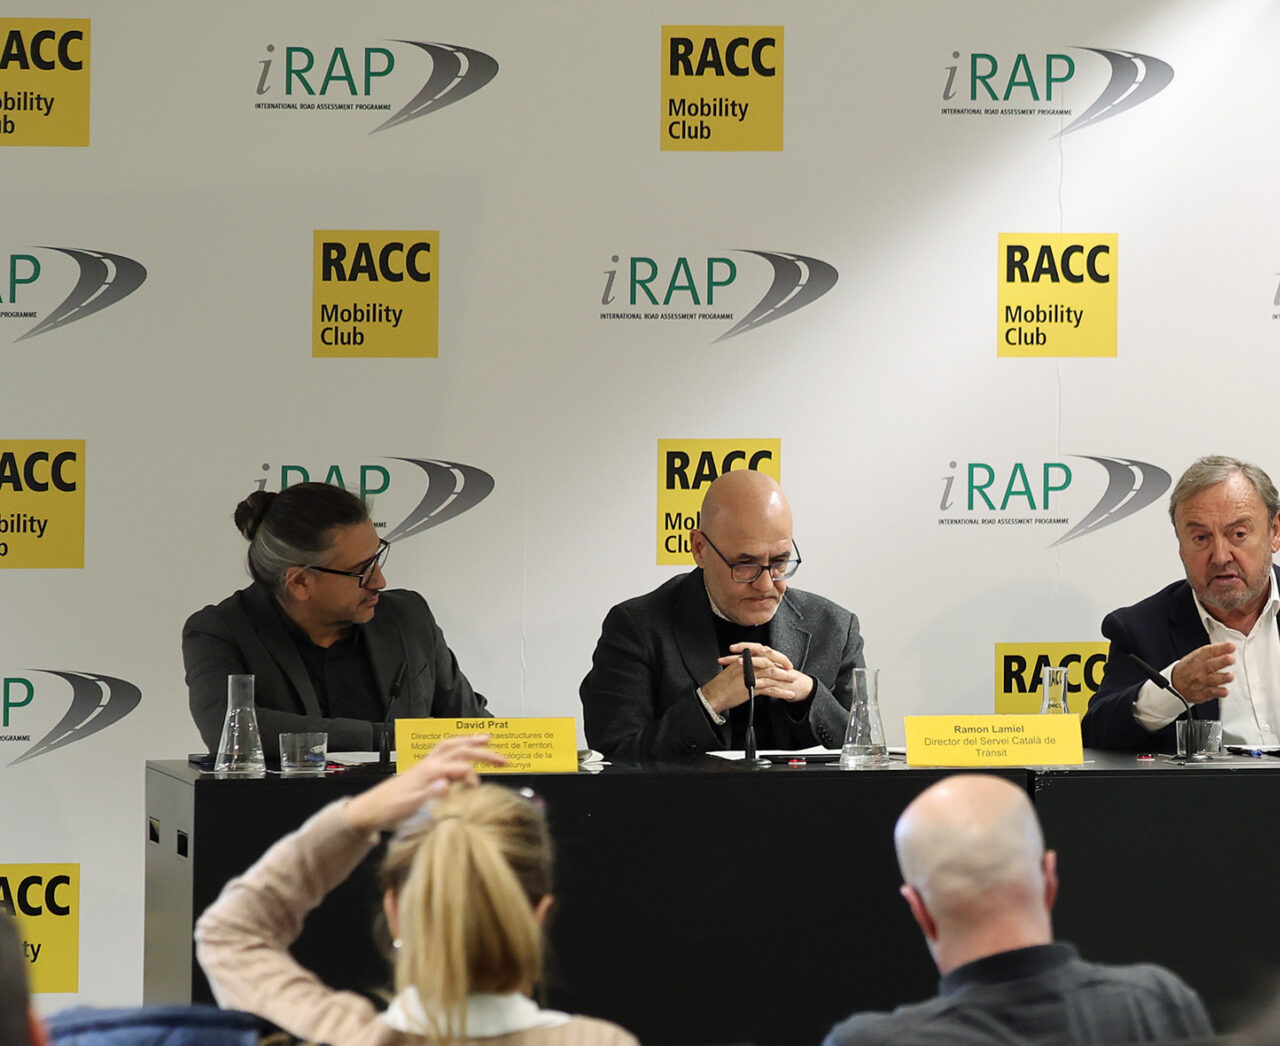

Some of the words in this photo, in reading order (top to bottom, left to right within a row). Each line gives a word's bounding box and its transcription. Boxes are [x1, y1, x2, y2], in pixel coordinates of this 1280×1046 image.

[0, 30, 83, 70] ACC
[670, 37, 775, 77] RACC
[257, 44, 394, 96] iRAP
[943, 51, 1075, 101] iRAP
[0, 91, 54, 116] bility
[669, 98, 748, 121] Mobility
[669, 120, 711, 139] Club
[322, 242, 430, 282] RACC
[1007, 245, 1109, 283] RACC
[602, 255, 737, 305] iRAP
[321, 303, 403, 327] Mobility
[1006, 304, 1083, 328] Mobility
[321, 326, 364, 345] Club
[1005, 327, 1046, 345] Club
[0, 451, 76, 492] ACC
[940, 461, 1072, 511] iRAP
[0, 514, 48, 538] bility
[456, 721, 485, 729] David
[488, 721, 509, 729] Prat
[954, 725, 989, 734] Ramon
[992, 725, 1024, 733] Lamiel
[924, 738, 960, 746] Director
[980, 737, 1009, 745] Servei
[1044, 736, 1056, 744] de
[0, 875, 70, 917] ACC
